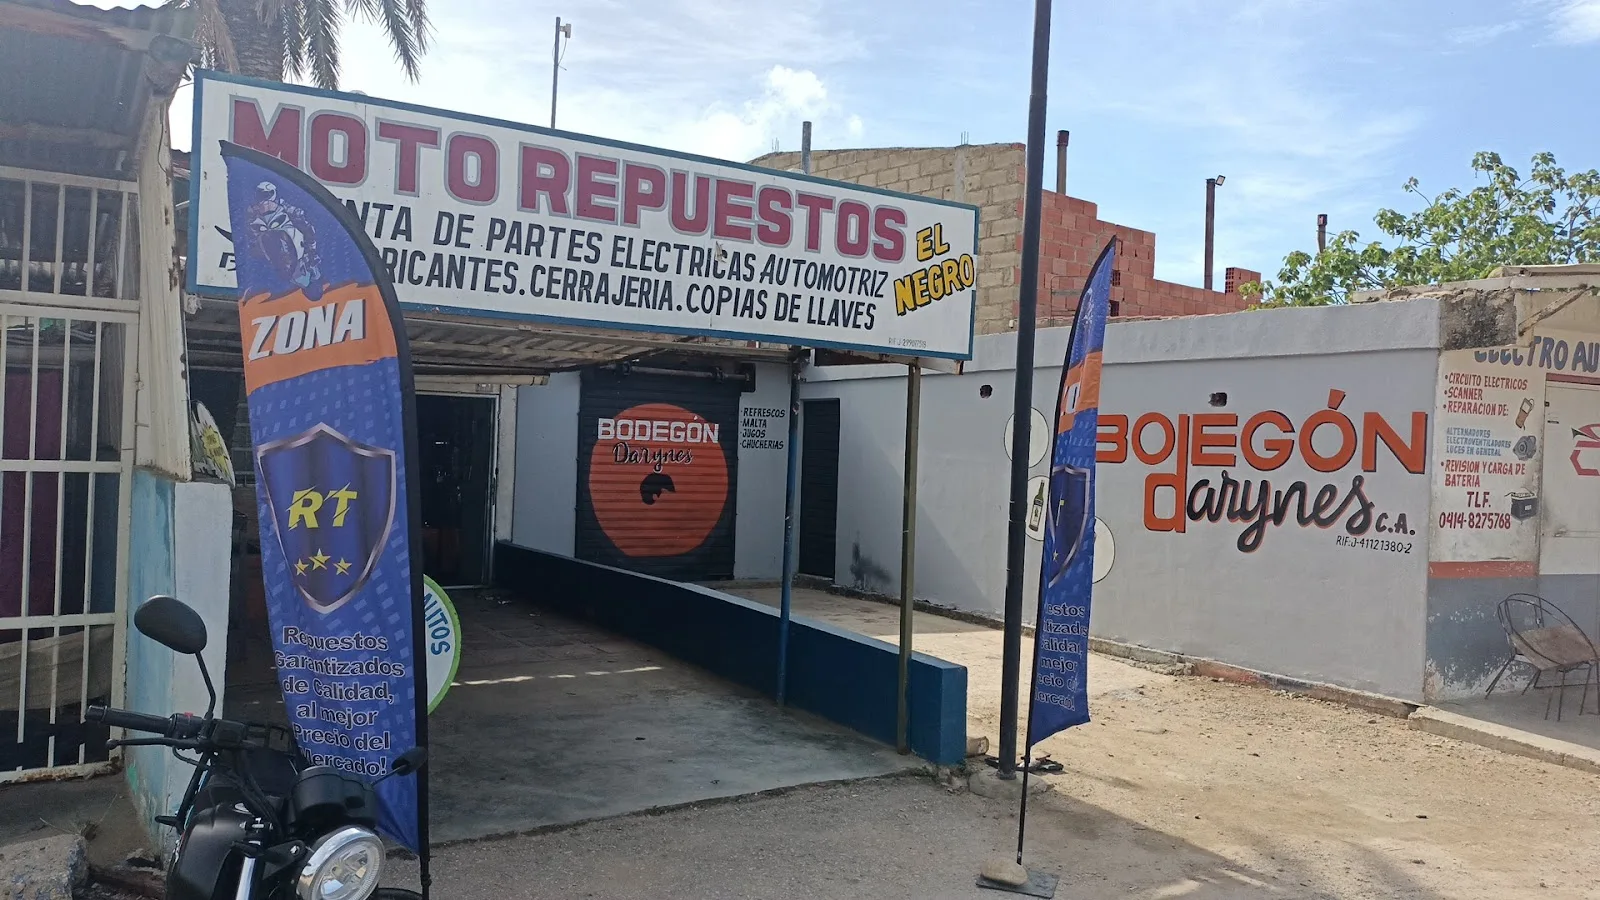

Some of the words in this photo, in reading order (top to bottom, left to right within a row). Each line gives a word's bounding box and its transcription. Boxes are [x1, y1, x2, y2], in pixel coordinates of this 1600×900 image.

[229, 94, 500, 206] MOTO
[517, 141, 908, 263] REPUESTOS
[341, 198, 412, 242] NTA
[433, 211, 475, 249] DE
[486, 217, 603, 265] PARTES
[610, 235, 756, 283] ELECTRICAS
[759, 253, 889, 299] AUTOMOTRIZ
[915, 222, 950, 262] EL
[382, 247, 525, 296] RICANTES.
[687, 283, 767, 320] COPIAS
[773, 292, 801, 323] DE
[807, 295, 877, 331] LLAVES
[894, 253, 975, 316] NEGRO
[248, 299, 367, 362] ZONA
[1449, 372, 1482, 386] CIRCUITO
[1484, 375, 1528, 390] ELECTRICOS
[1448, 386, 1483, 401] SCANNER
[743, 407, 786, 418] REFRESCOS
[1447, 401, 1497, 416] REPARACION
[742, 418, 767, 428] MALTA
[742, 428, 766, 438] JUGOS
[741, 439, 784, 450] CHUCHERIAS
[1446, 445, 1465, 454] LUCES
[1466, 447, 1475, 456] EN
[1476, 448, 1502, 457] GENERAL
[612, 441, 694, 474] Darynes
[1445, 460, 1480, 473] REVISION
[1482, 461, 1487, 474] Y
[1488, 462, 1513, 475] CARGA
[1515, 463, 1526, 475] DE
[1444, 474, 1480, 488] BATERIA
[286, 481, 357, 531] RT
[1466, 491, 1492, 508] TLF.
[1375, 512, 1416, 536] C.A.
[1439, 511, 1511, 530] 0414-8275768
[1046, 602, 1085, 618] estos
[275, 650, 405, 677] Garantizados
[1040, 656, 1078, 674] mejo
[283, 676, 309, 694] de
[313, 679, 394, 704] Calidad,
[296, 701, 317, 719] al
[320, 706, 379, 730] mejor
[292, 722, 350, 748] Precio
[354, 731, 391, 751] del
